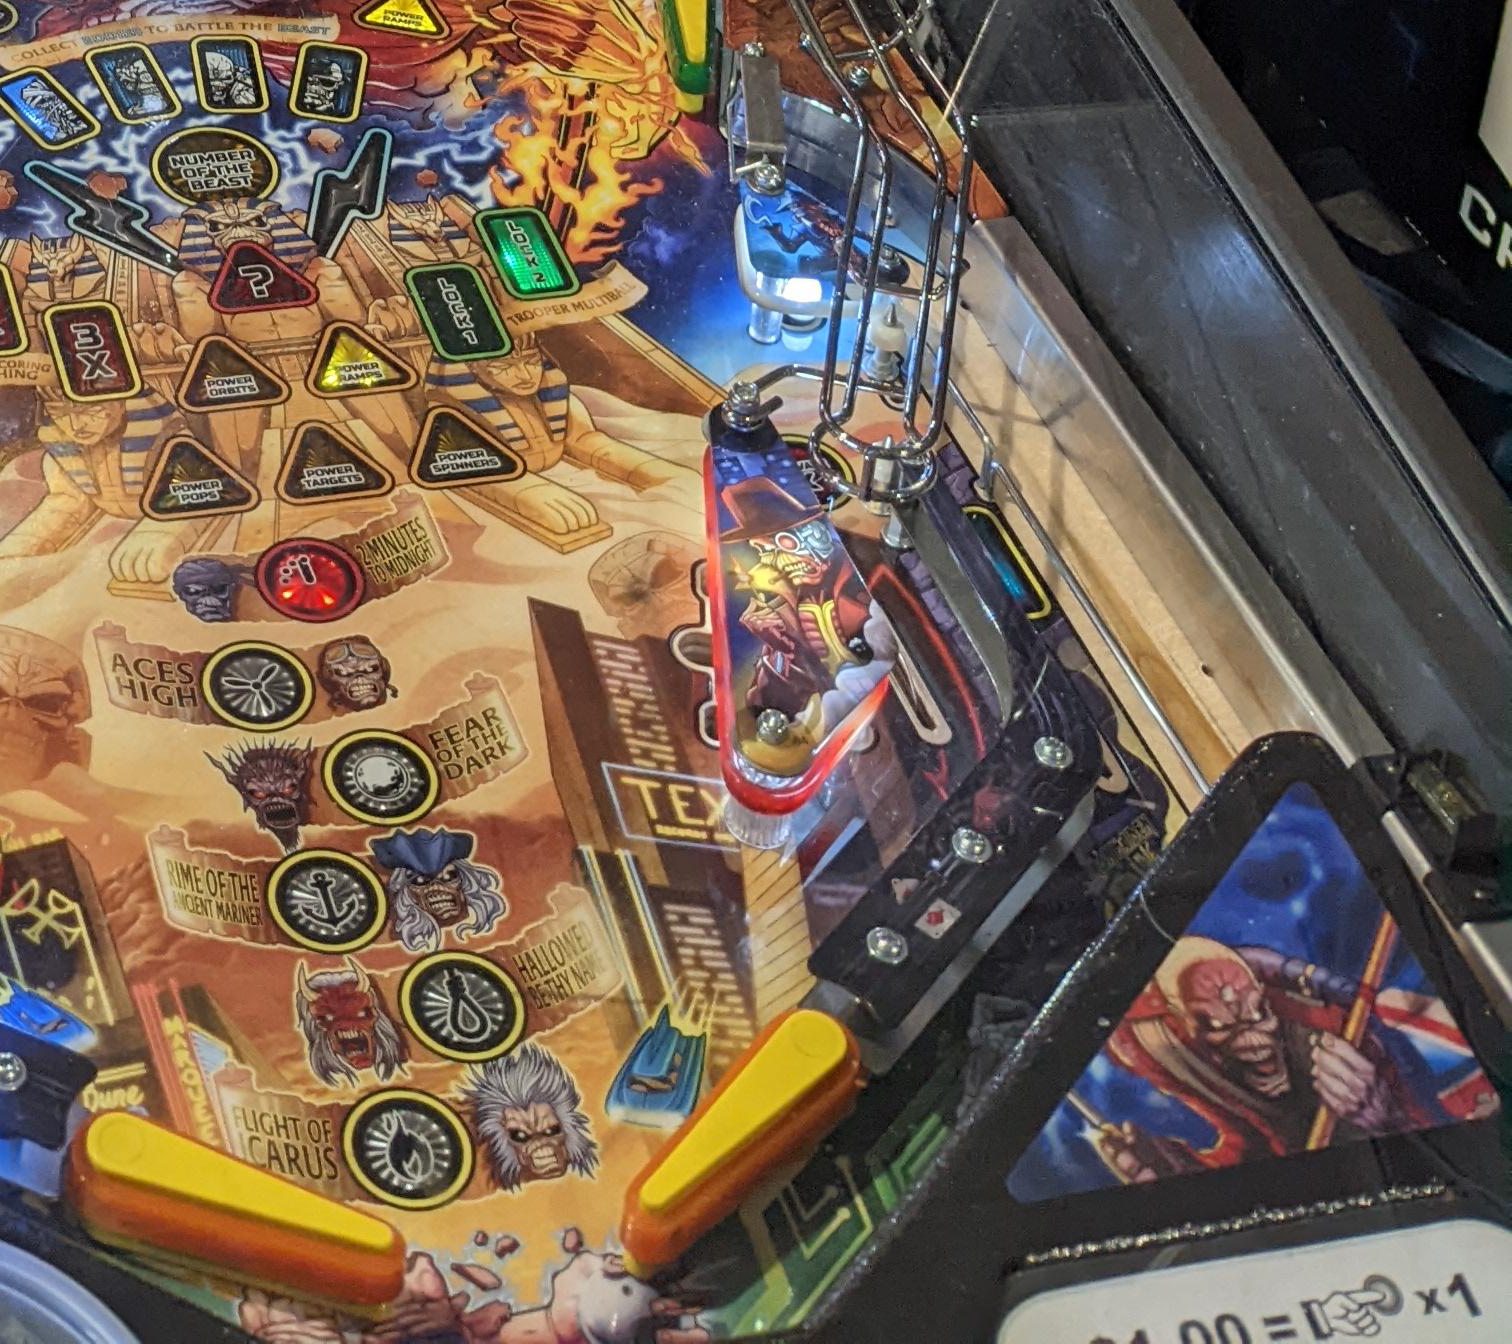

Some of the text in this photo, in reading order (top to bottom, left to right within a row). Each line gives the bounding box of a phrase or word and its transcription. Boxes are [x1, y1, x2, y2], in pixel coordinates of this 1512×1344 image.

[382, 15, 423, 28] RAMPS
[383, 9, 424, 22] POWER
[11, 40, 79, 62] COLLECT
[145, 24, 169, 33] TO
[175, 22, 233, 33] BATTLE
[241, 21, 272, 31] THE
[168, 148, 257, 169] NUMBER
[181, 162, 254, 180] OF THE
[189, 174, 253, 192] BEAST
[505, 219, 541, 270] LOCK
[437, 276, 479, 346] LOCK 1
[506, 281, 637, 327] TROOPER MULTIBALL
[204, 375, 254, 389] POWER
[207, 383, 259, 398] ORBITS
[431, 457, 502, 476] SPINNERS
[436, 447, 488, 462] POWER
[170, 478, 223, 495] POWER
[301, 473, 365, 490] TARGETS
[305, 463, 355, 479] POWER
[179, 488, 220, 505] POPS
[355, 516, 428, 567] 2 MINUTES
[367, 539, 436, 585] TO MIDNIGHT
[112, 652, 194, 684] ACES
[115, 675, 198, 708] HIGH
[428, 706, 502, 750] FEAR
[436, 723, 508, 763] OF THE
[443, 735, 515, 780] DARK
[165, 857, 260, 904] RIME OF THE
[173, 890, 263, 926] ANCIENT MARINER
[528, 983, 551, 1009] BE
[544, 969, 575, 1004] THY
[81, 1081, 145, 1112] Dune
[231, 1105, 333, 1144] FLIGHT OF
